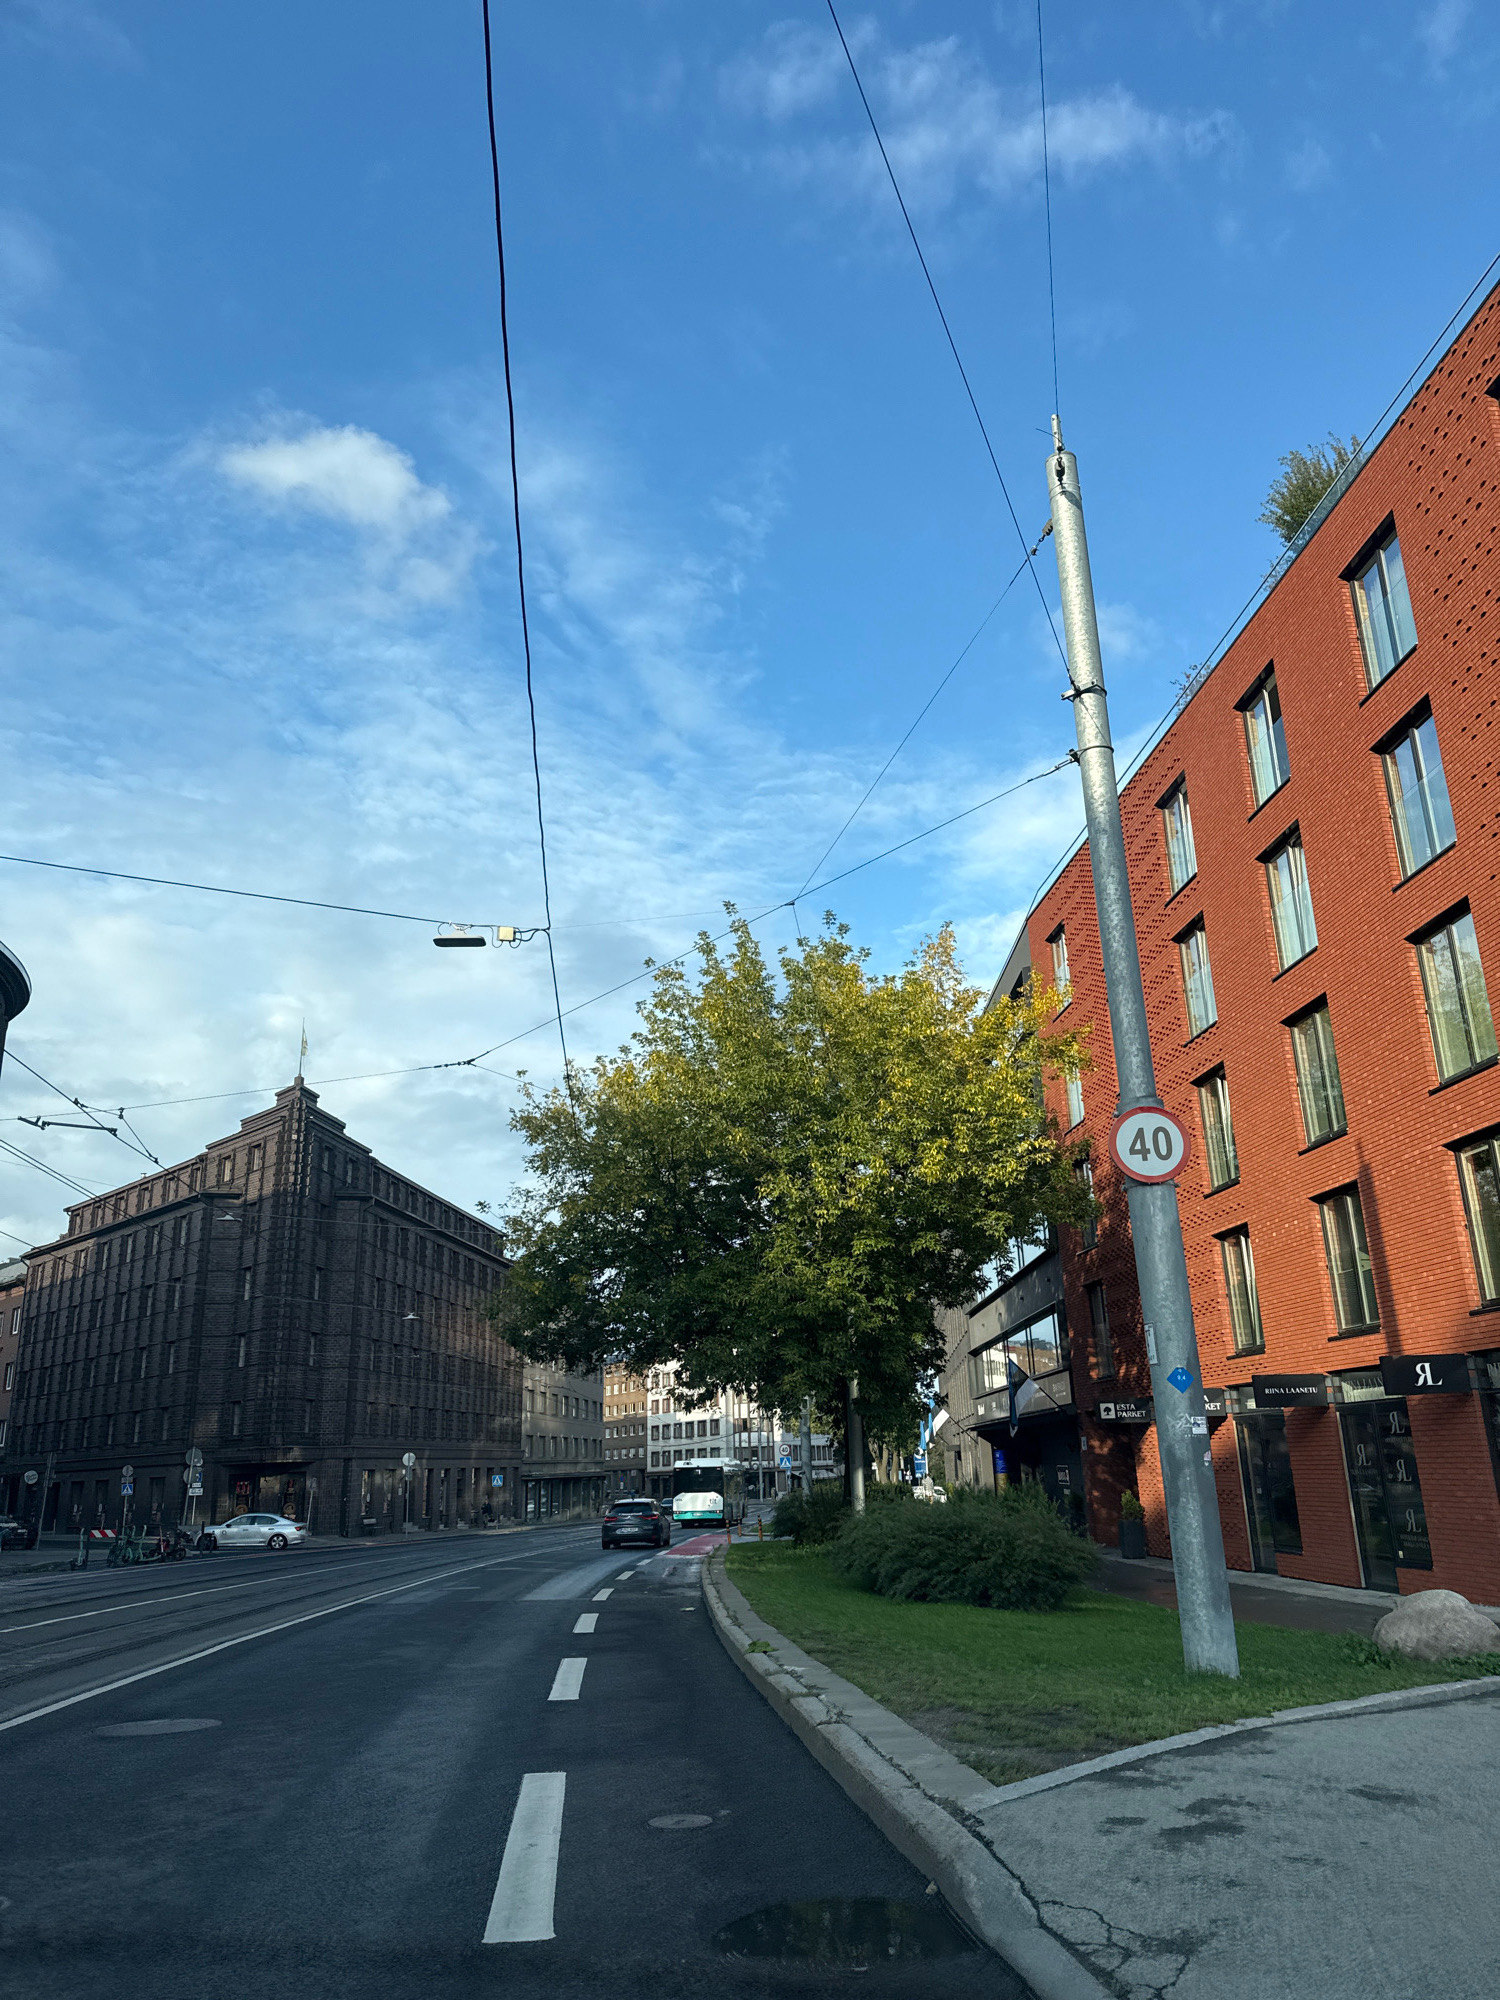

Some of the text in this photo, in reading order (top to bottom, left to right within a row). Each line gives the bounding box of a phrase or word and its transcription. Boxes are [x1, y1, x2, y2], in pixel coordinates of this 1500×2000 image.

[1129, 1126, 1173, 1161] 40
[1204, 1402, 1221, 1410] KET
[1117, 1410, 1146, 1418] PARKET
